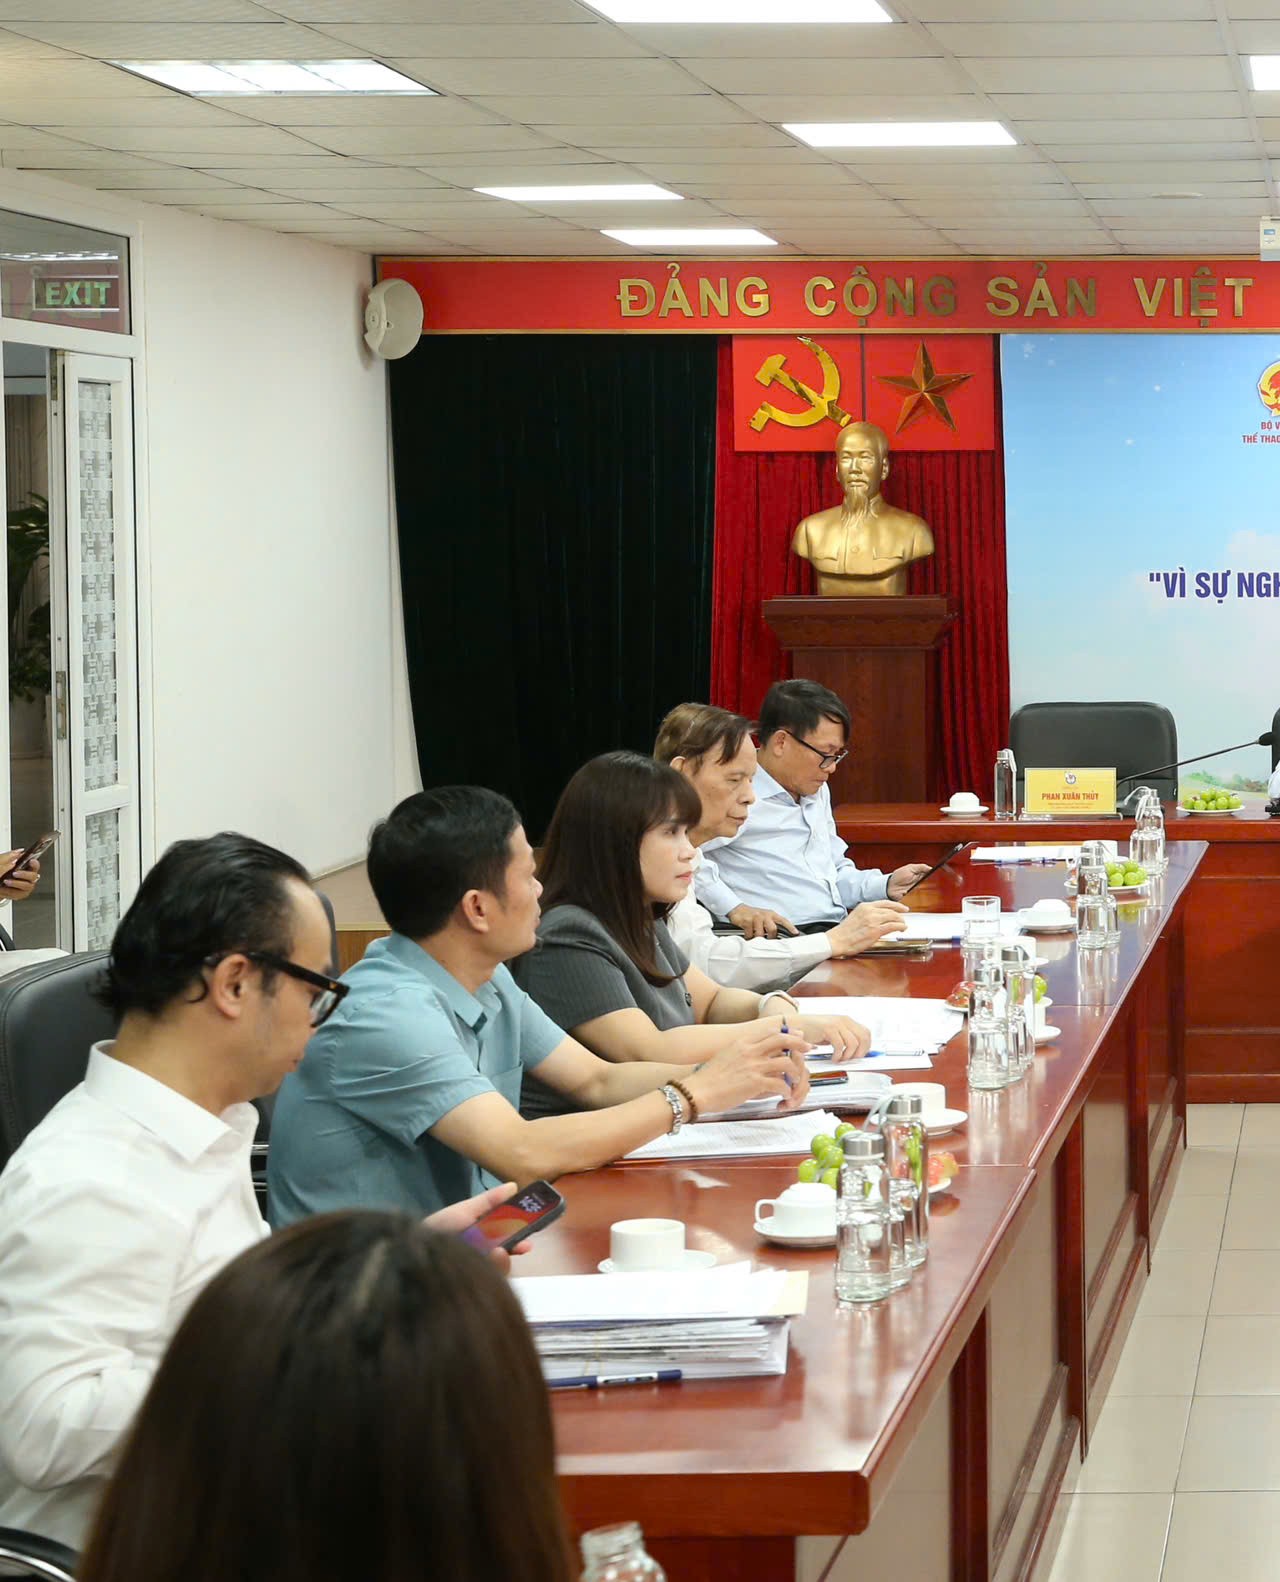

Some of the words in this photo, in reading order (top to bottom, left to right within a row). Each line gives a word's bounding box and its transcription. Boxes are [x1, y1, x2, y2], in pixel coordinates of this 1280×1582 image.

[45, 281, 111, 305] EXIT
[616, 262, 770, 317] ĐẢNG
[804, 265, 957, 327] CỘNG
[985, 261, 1096, 317] SẢN
[1133, 266, 1253, 327] VIỆT
[1260, 420, 1272, 432] BỘ
[1149, 567, 1186, 598] "VÌ
[1195, 570, 1231, 604] SỰ
